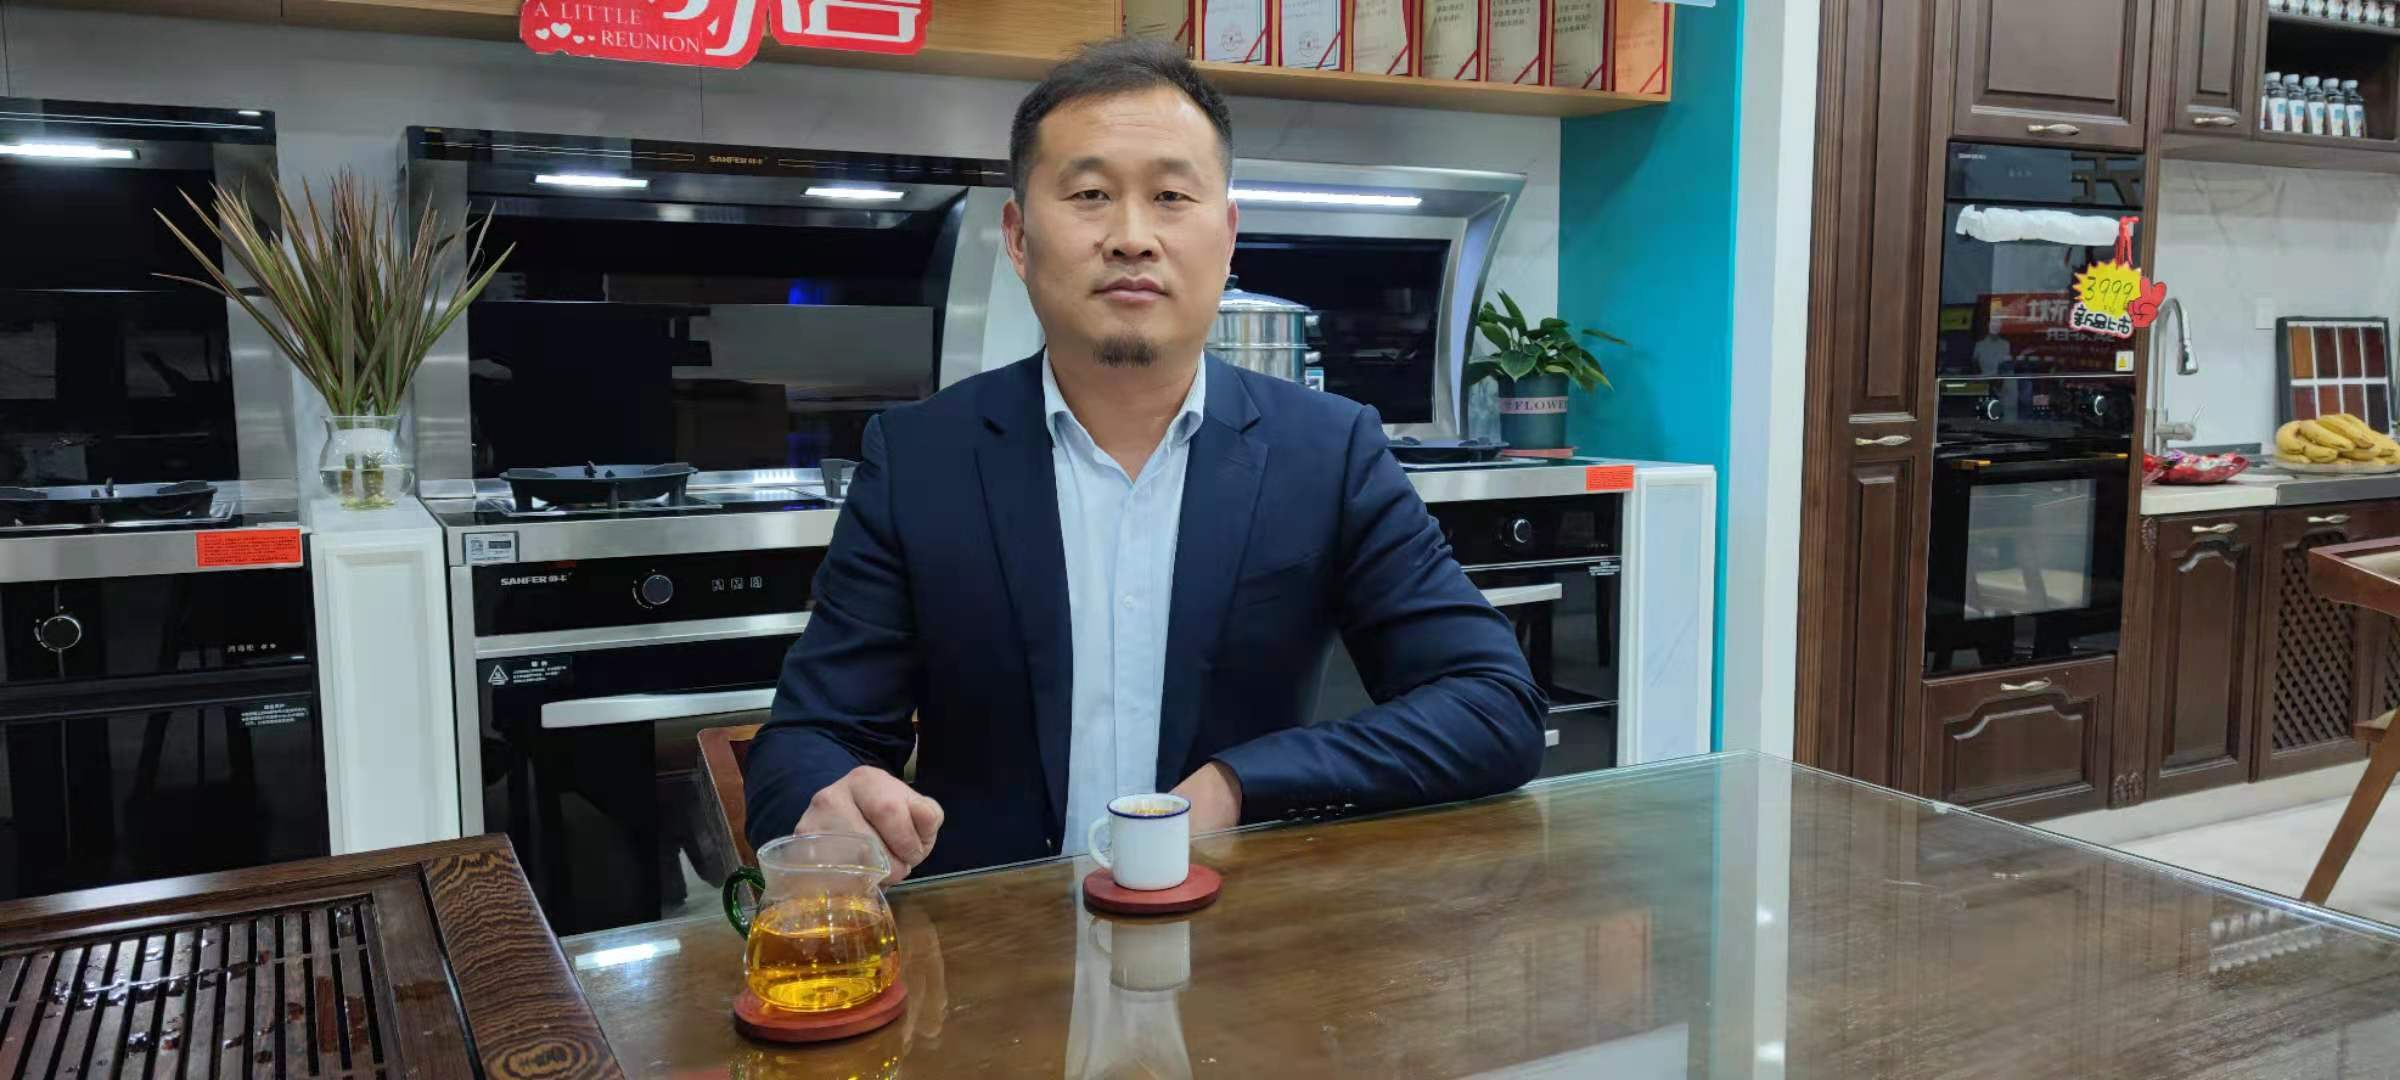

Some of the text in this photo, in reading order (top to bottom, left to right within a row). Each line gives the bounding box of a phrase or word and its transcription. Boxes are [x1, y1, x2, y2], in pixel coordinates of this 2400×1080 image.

[534, 2, 641, 26] A LITTLE
[601, 29, 702, 53] REUNION
[2084, 276, 2133, 309] 3999
[2074, 304, 2131, 335] 新品上市
[500, 575, 547, 586] SANFER
